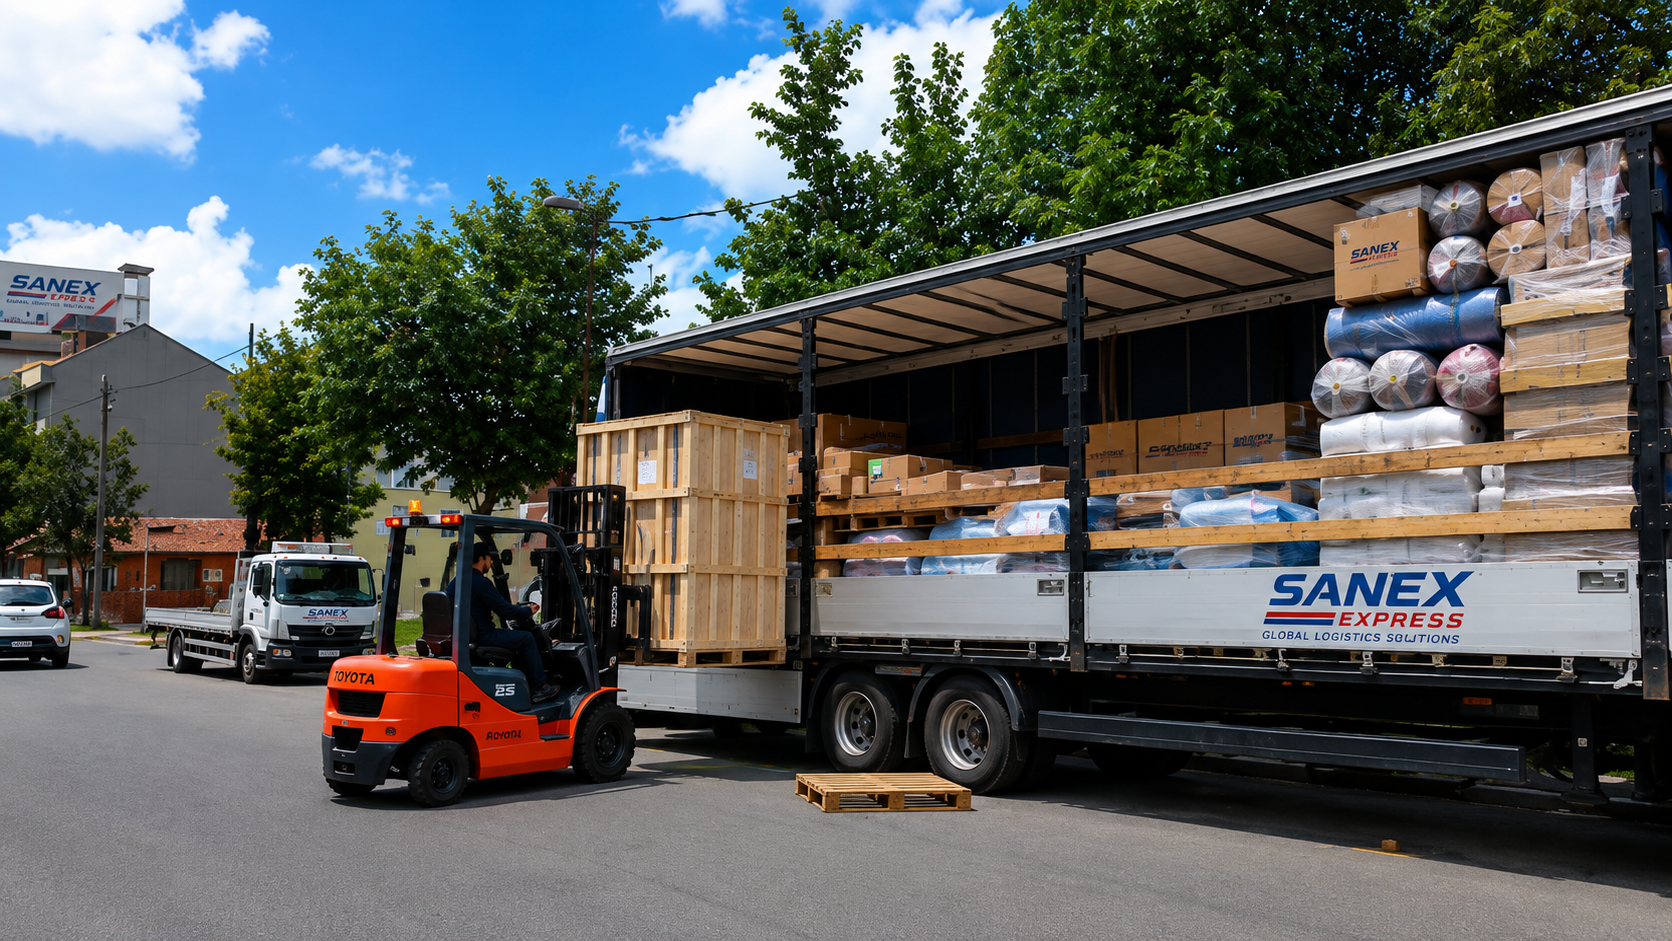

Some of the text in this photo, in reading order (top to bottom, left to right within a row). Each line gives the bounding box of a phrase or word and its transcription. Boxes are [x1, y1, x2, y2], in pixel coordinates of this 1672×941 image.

[1351, 241, 1399, 259] SANEX
[10, 274, 101, 295] SANEX
[1269, 571, 1475, 606] SANEX
[1339, 612, 1464, 628] EXPRESS
[1262, 630, 1309, 641] GLOBAL
[1314, 631, 1381, 642] LOGISTICS
[333, 670, 375, 685] TOYOTA
